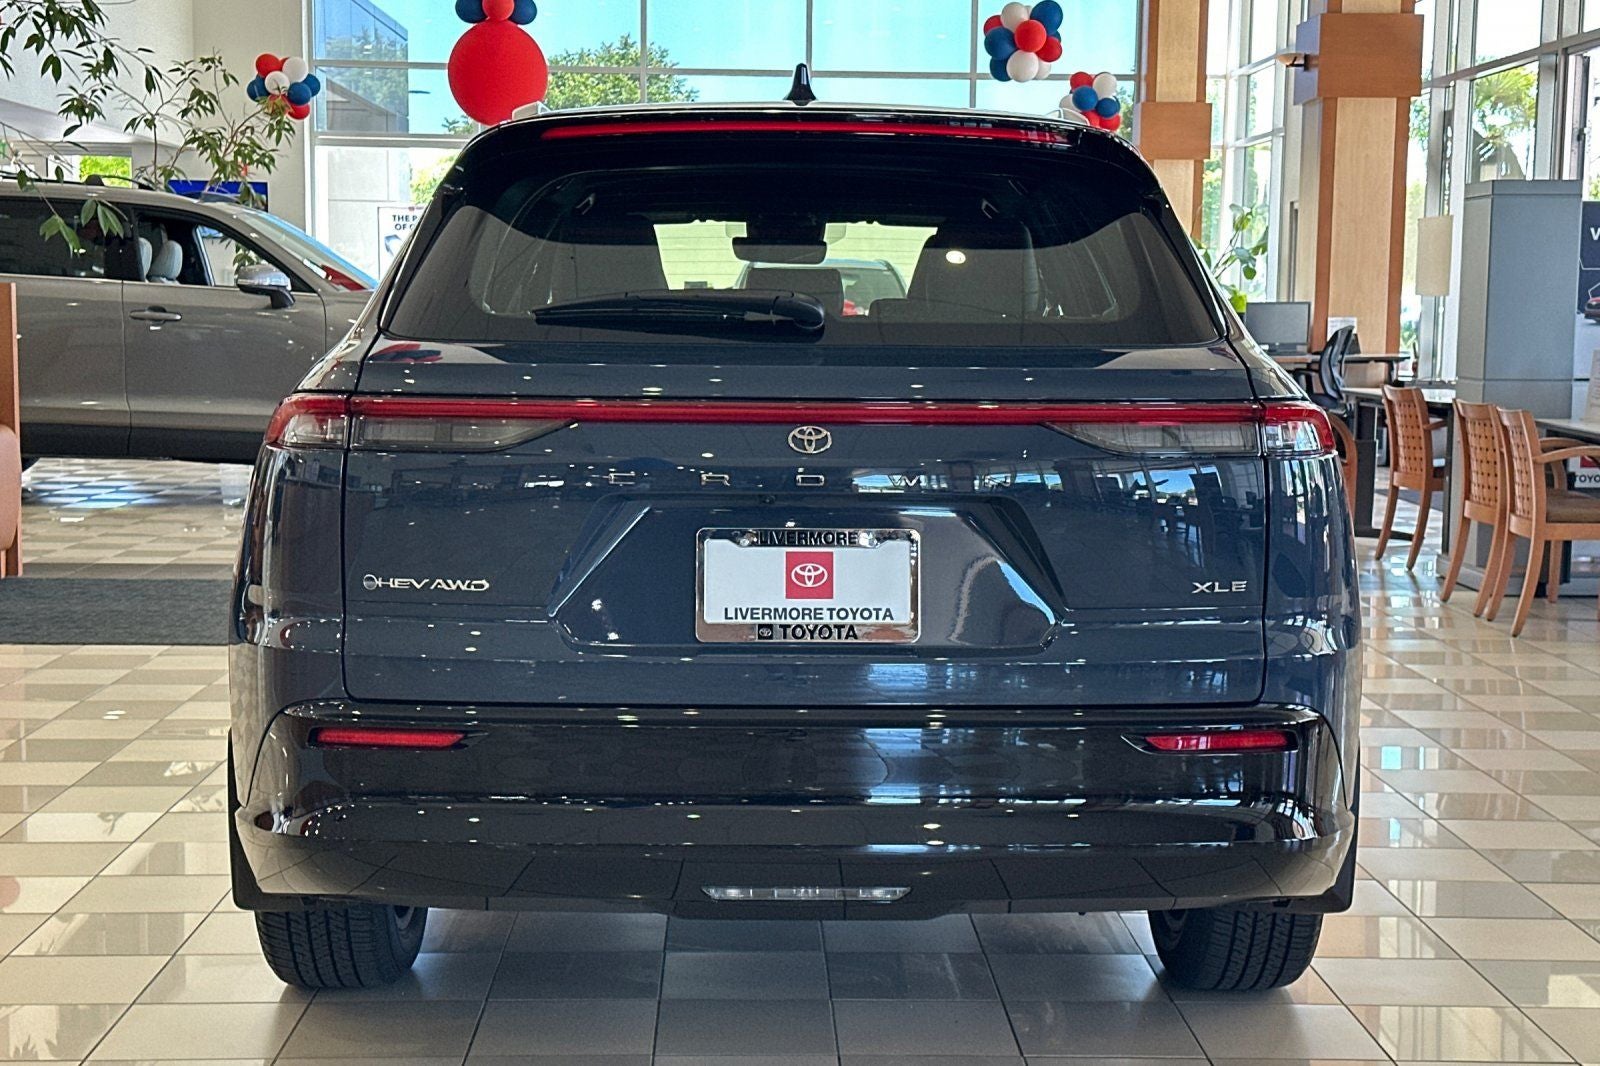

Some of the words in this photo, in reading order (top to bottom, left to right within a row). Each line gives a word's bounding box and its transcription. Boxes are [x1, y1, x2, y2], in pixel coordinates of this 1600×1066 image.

[394, 223, 407, 231] OF
[759, 530, 859, 546] LIVERMORE
[430, 578, 490, 591] AWD
[1191, 580, 1248, 593] XLE
[724, 607, 824, 621] LIVERMORE
[826, 607, 894, 621] TOYOTA
[779, 624, 858, 640] TOYOTA
